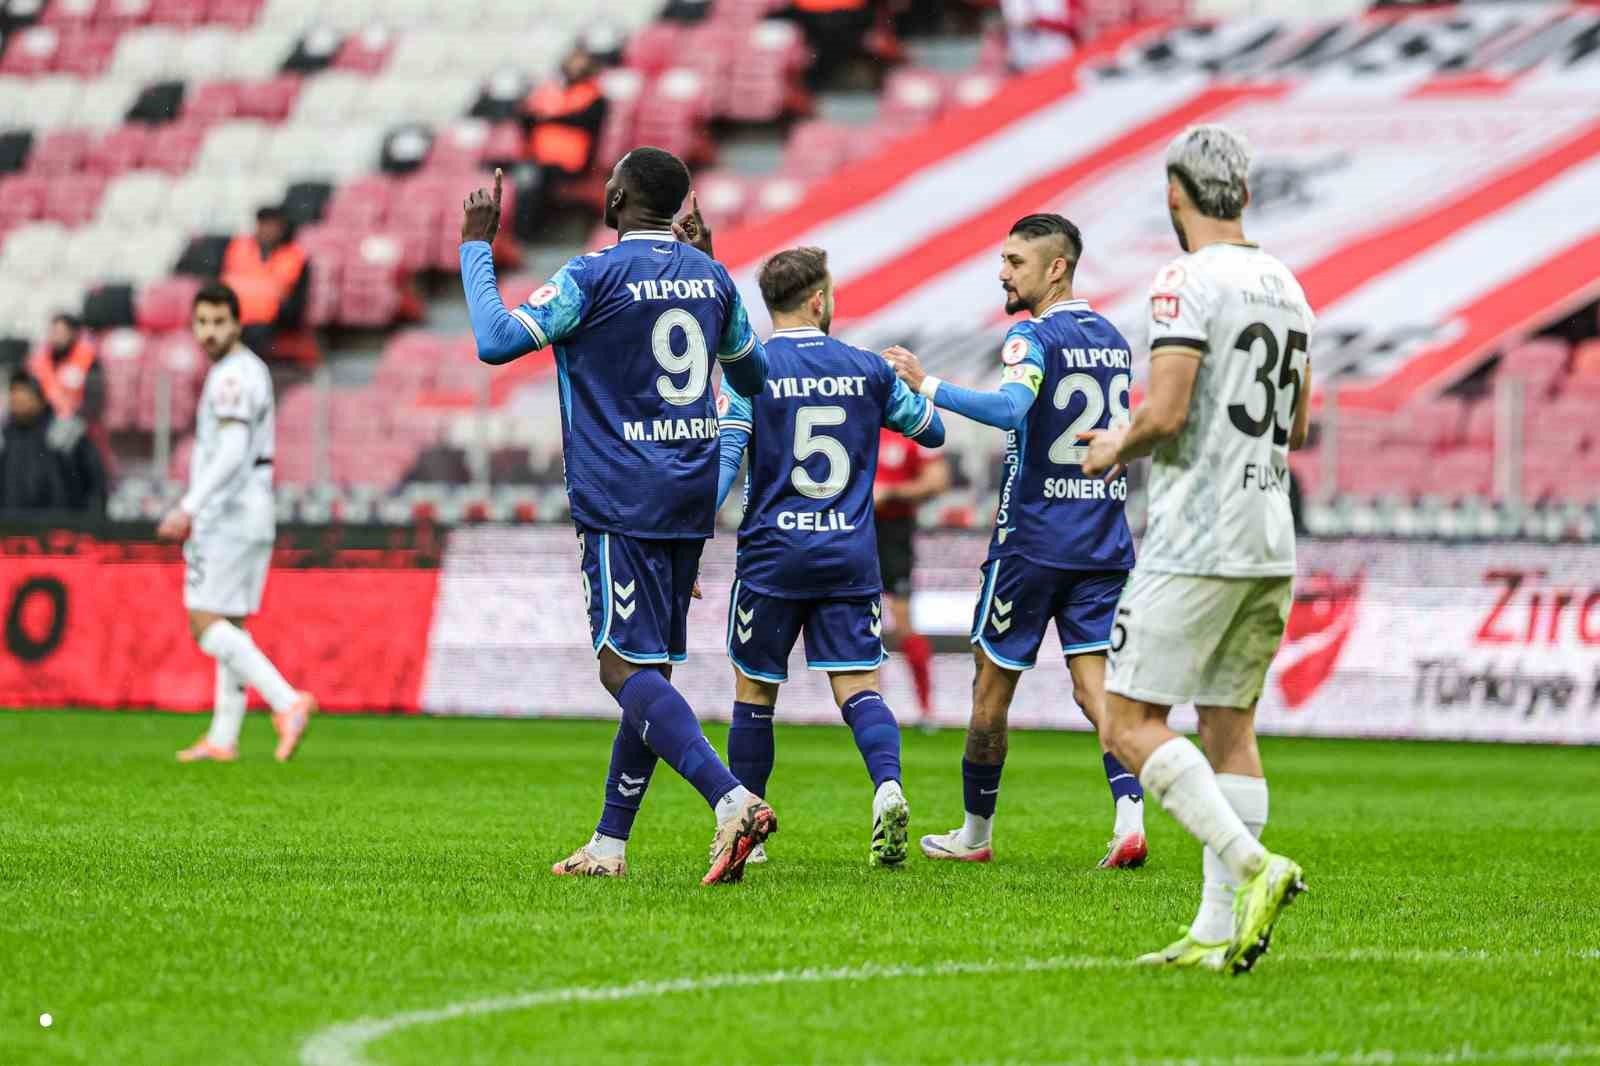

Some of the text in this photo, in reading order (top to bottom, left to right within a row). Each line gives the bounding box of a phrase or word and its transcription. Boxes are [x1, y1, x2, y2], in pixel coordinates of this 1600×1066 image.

[626, 278, 718, 301] YILPORT
[651, 307, 708, 407] 9
[767, 376, 867, 399] YILPORT
[1227, 321, 1309, 447] 35
[791, 405, 850, 500] 5
[1043, 477, 1106, 499] SONER
[776, 508, 856, 532] CELİL
